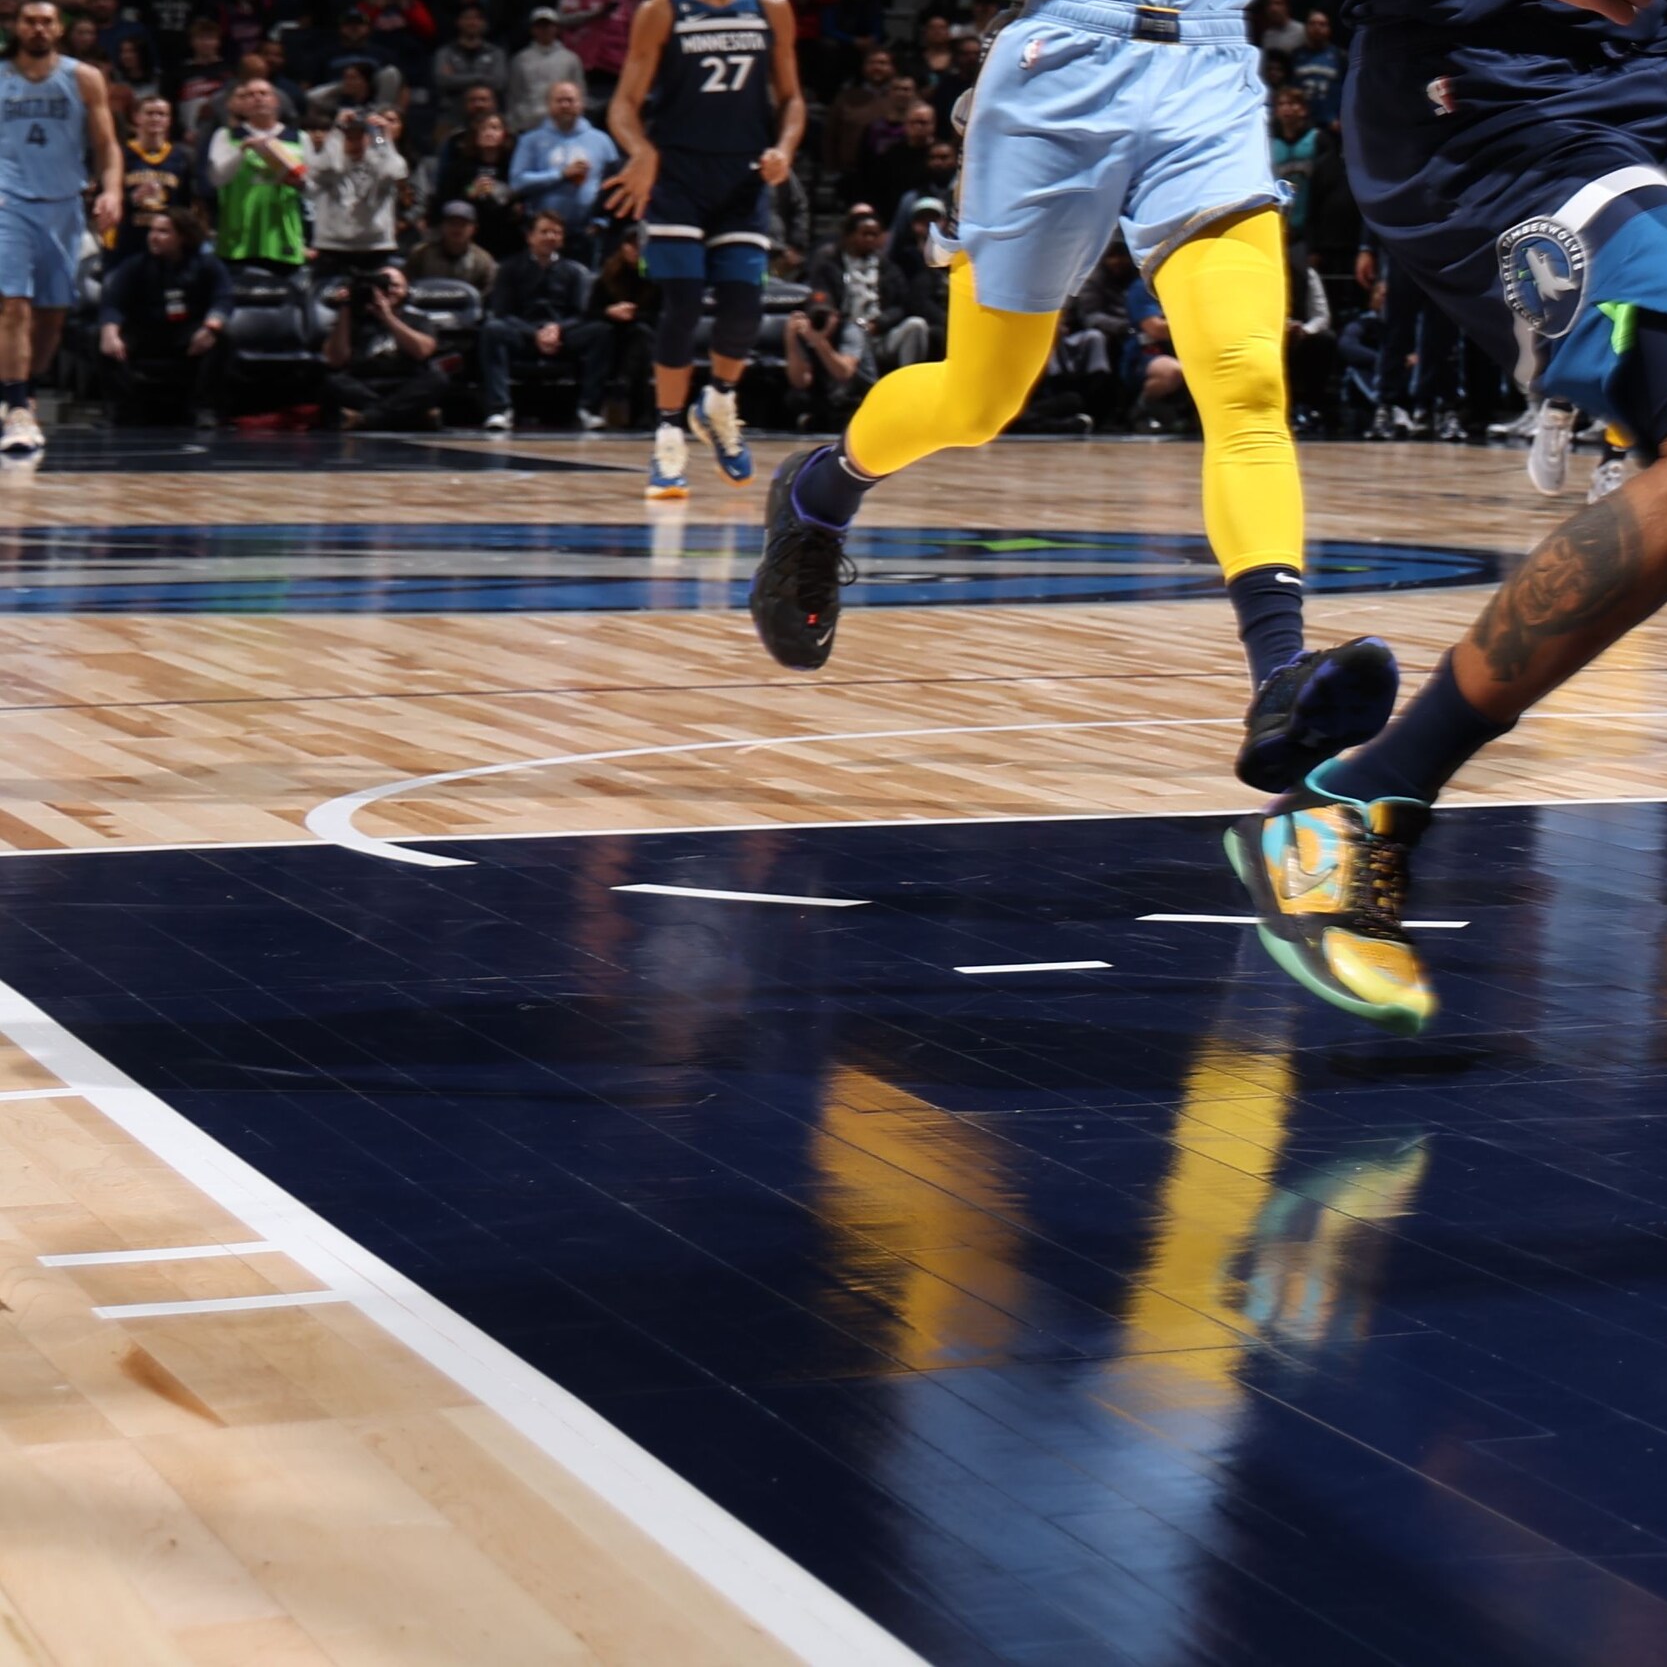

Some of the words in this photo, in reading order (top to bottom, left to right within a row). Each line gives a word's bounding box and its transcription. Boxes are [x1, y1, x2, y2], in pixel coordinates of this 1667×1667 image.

[681, 32, 766, 54] MINNESOTA
[699, 55, 756, 93] 27
[27, 122, 48, 146] 4
